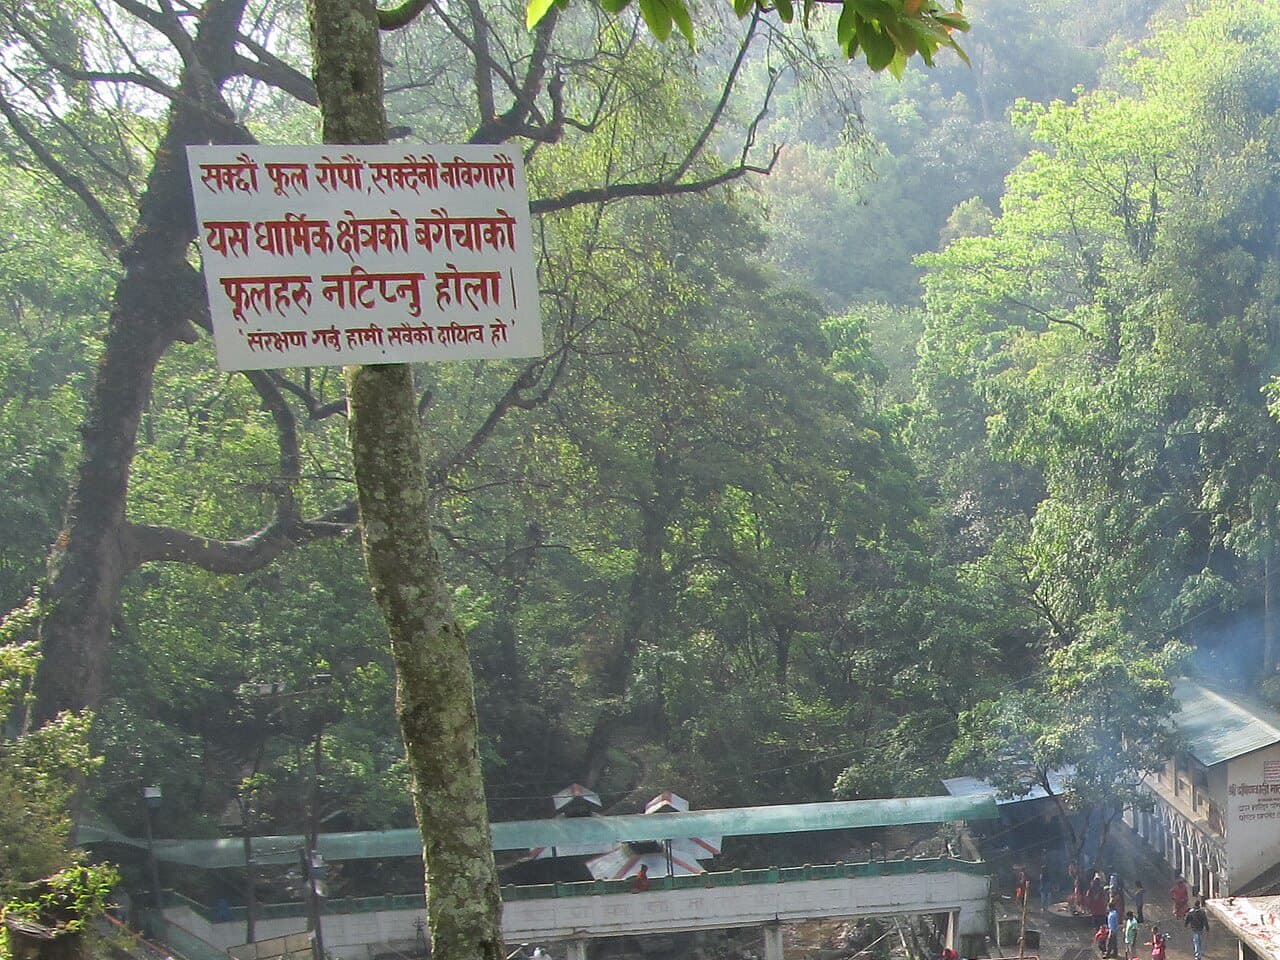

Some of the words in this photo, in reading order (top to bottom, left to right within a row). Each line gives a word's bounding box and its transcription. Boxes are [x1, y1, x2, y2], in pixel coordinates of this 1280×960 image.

[264, 162, 310, 199] फूल
[203, 220, 252, 259] यस
[254, 212, 335, 257] धार्मिक
[337, 209, 409, 262] क्षेत्रको
[415, 208, 517, 254] बगैचाको
[321, 265, 426, 318] नटिप्नु
[345, 323, 384, 350] हामी
[438, 320, 485, 347] दायित्व
